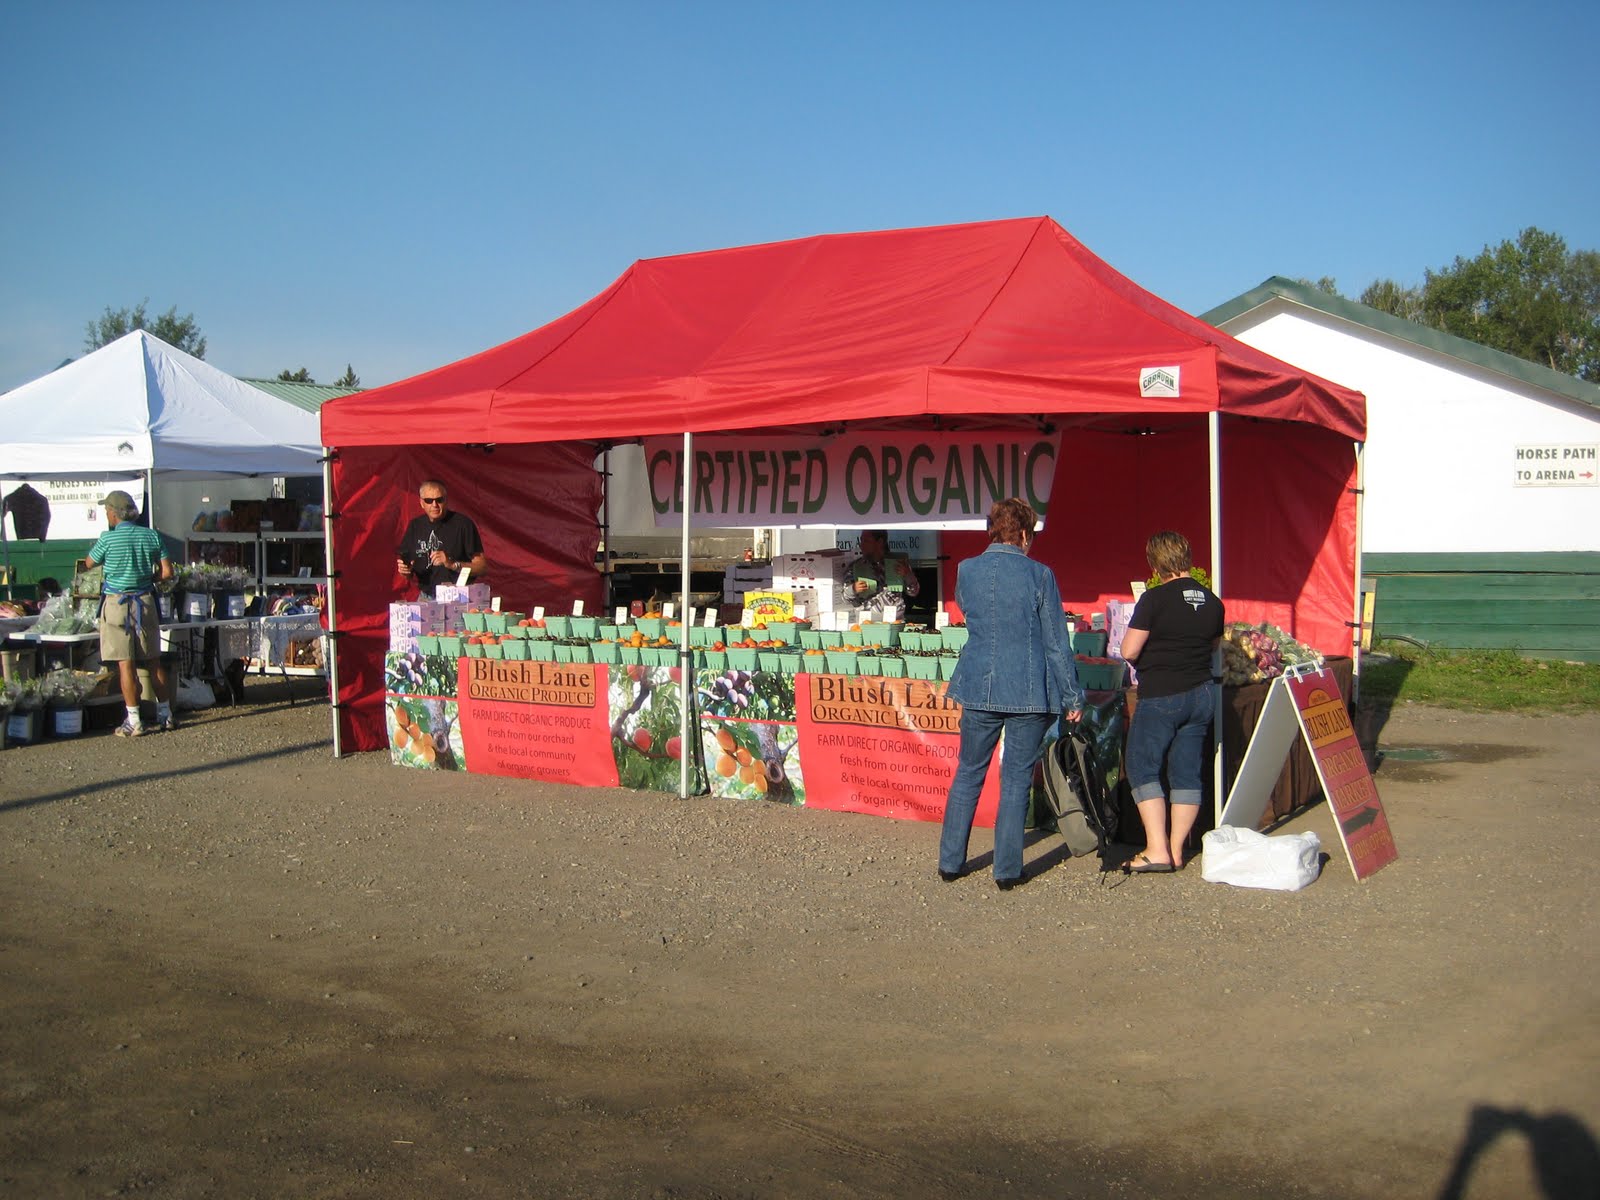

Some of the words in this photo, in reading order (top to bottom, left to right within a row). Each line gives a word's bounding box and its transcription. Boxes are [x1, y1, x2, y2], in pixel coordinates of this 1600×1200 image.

[1516, 448, 1557, 460] HORSE
[1563, 448, 1596, 460] PATH
[649, 448, 828, 514] CERTIFIED
[845, 442, 1054, 516] ORGANIC
[1517, 470, 1532, 480] TO
[1535, 470, 1575, 480] ARENA
[909, 536, 920, 548] BC
[474, 659, 531, 684] Blush
[537, 663, 590, 688] Lane
[470, 683, 529, 701] ORGANIC
[532, 687, 595, 705] PRODUCE
[817, 677, 894, 706] Blush
[472, 709, 493, 720] FARM
[493, 710, 519, 723] DIRECT
[519, 713, 553, 726] ORGANIC
[555, 716, 591, 729] PRODUCE
[813, 704, 890, 724] ORGANIC
[1304, 712, 1332, 741] BLUSH
[1329, 707, 1349, 734] LANE
[487, 727, 506, 738] fresh
[507, 730, 526, 741] from
[528, 732, 542, 742] our
[542, 732, 575, 745] orchard
[817, 734, 846, 746] FARM
[847, 735, 878, 750] DIRECT
[879, 739, 924, 756] ORGANIC
[487, 743, 494, 752] &
[495, 744, 509, 755] the
[509, 745, 528, 757] local
[529, 747, 576, 763] community
[1320, 746, 1362, 778] ORGANIC
[506, 761, 535, 774] organic
[536, 766, 571, 777] growers
[839, 755, 862, 767] fresh
[864, 758, 887, 771] from
[889, 763, 909, 773] our
[911, 764, 951, 778] orchard
[841, 772, 849, 783] &
[851, 773, 865, 786] the
[866, 775, 890, 789] local
[850, 792, 862, 802] of
[863, 794, 900, 808] organic
[903, 799, 943, 815] growers
